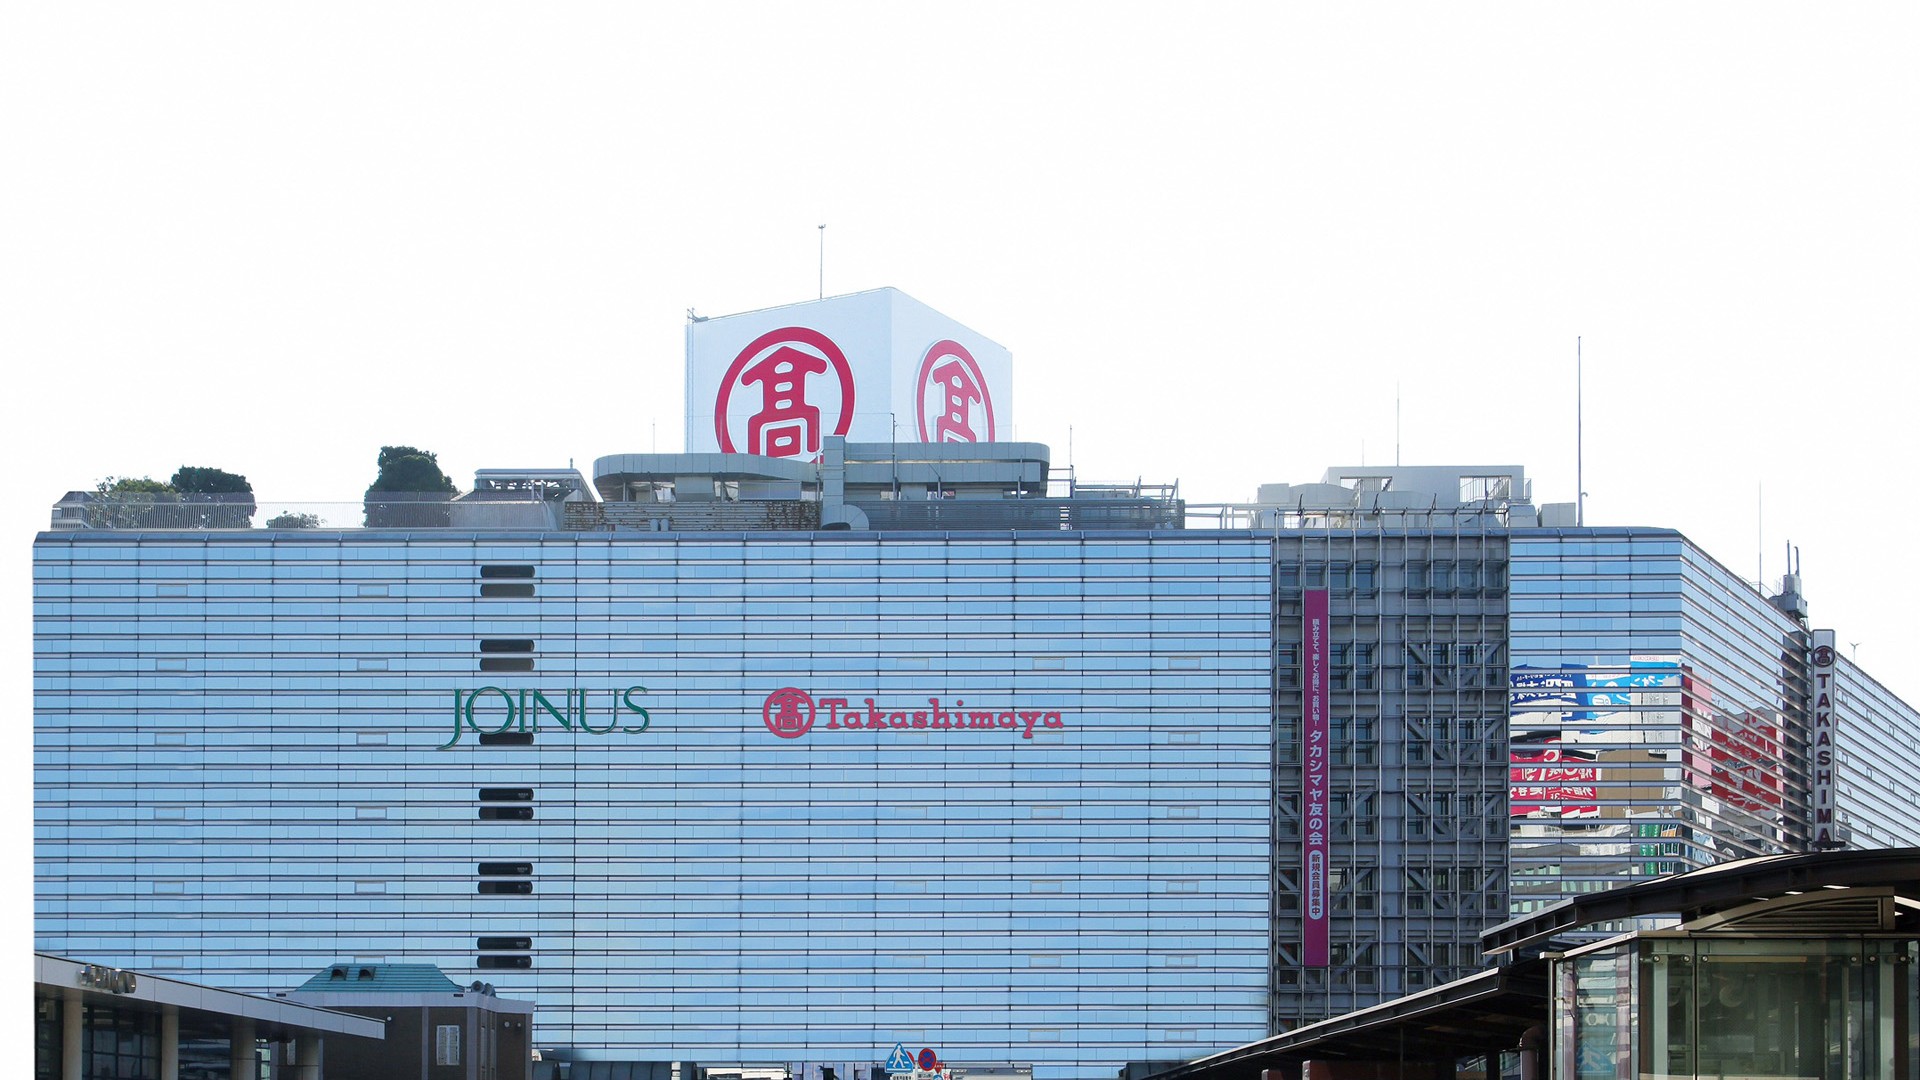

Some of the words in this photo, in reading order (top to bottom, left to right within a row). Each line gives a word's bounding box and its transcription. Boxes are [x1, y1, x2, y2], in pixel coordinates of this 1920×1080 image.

[437, 686, 650, 749] JOINUS
[819, 698, 1063, 738] Takashimaya
[1308, 729, 1323, 845] タカシマヤ友の会
